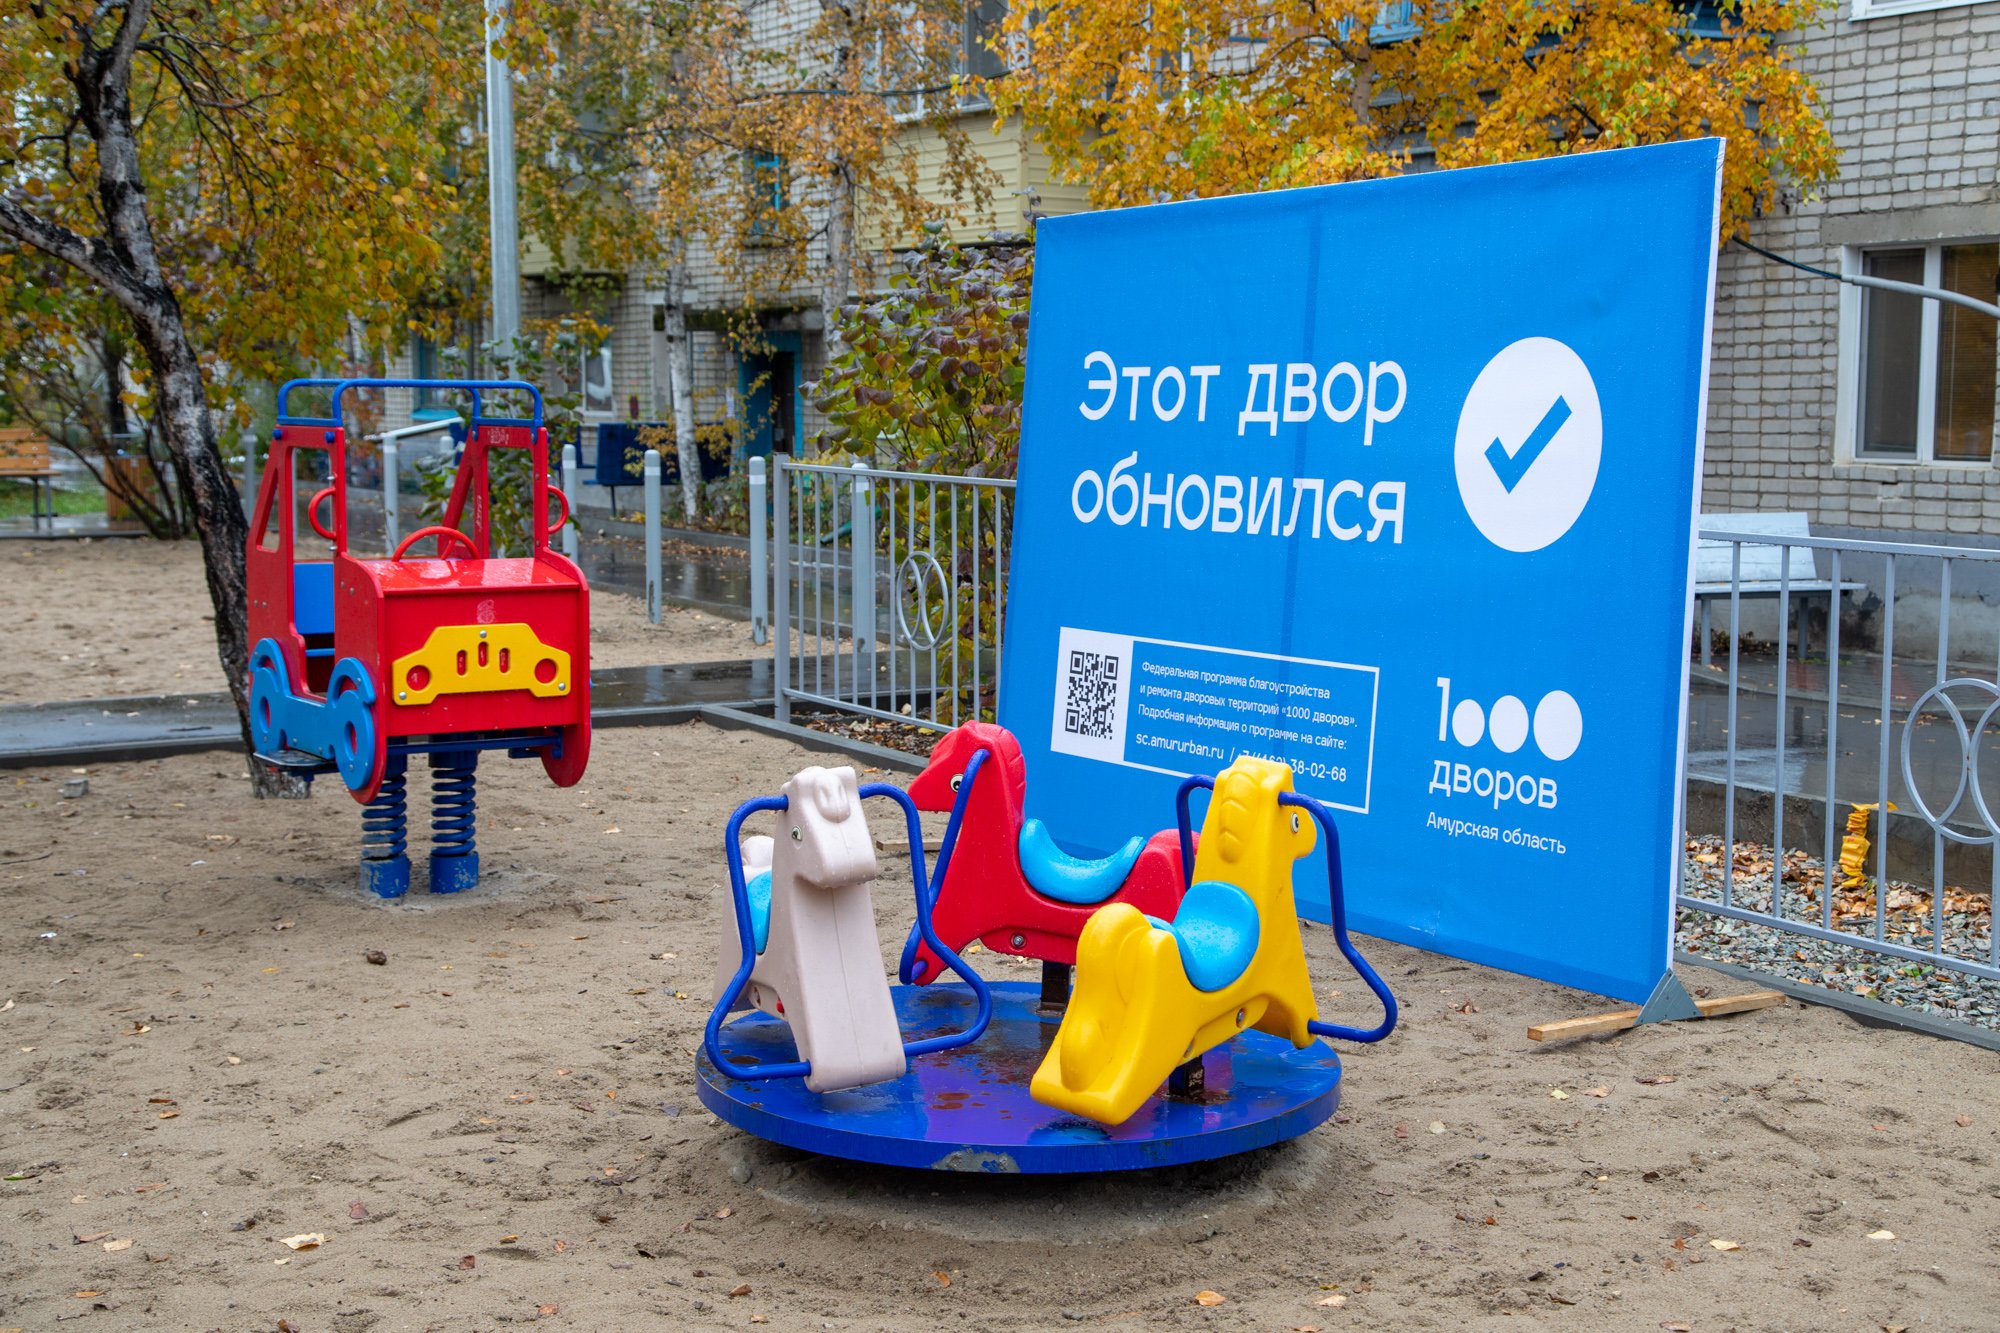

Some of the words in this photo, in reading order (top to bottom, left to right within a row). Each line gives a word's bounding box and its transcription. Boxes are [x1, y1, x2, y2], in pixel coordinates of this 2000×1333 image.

[1079, 350, 1221, 422] Этот
[1238, 360, 1407, 446] двор
[1071, 451, 1406, 544] обновился
[1142, 661, 1199, 680] Федеральная
[1200, 671, 1247, 687] программа
[1248, 676, 1331, 699] благоустройства
[1138, 703, 1185, 723] Подробная
[1186, 713, 1240, 732] информация
[1241, 723, 1247, 733] о
[1249, 724, 1299, 741] программе
[1300, 732, 1313, 745] на
[1315, 734, 1347, 750] сайте:
[1140, 684, 1146, 694] и
[1147, 686, 1182, 699] ремонта
[1183, 691, 1226, 707] дворовых
[1228, 697, 1279, 716] территорий
[1281, 705, 1311, 720] «1000
[1312, 711, 1358, 728] дворов».
[1135, 733, 1225, 760] sc.amururban.ru
[1290, 758, 1347, 783] 38-02-68
[1428, 759, 1558, 810] дворов
[1426, 811, 1499, 841] Амурская
[1502, 827, 1567, 855] область
